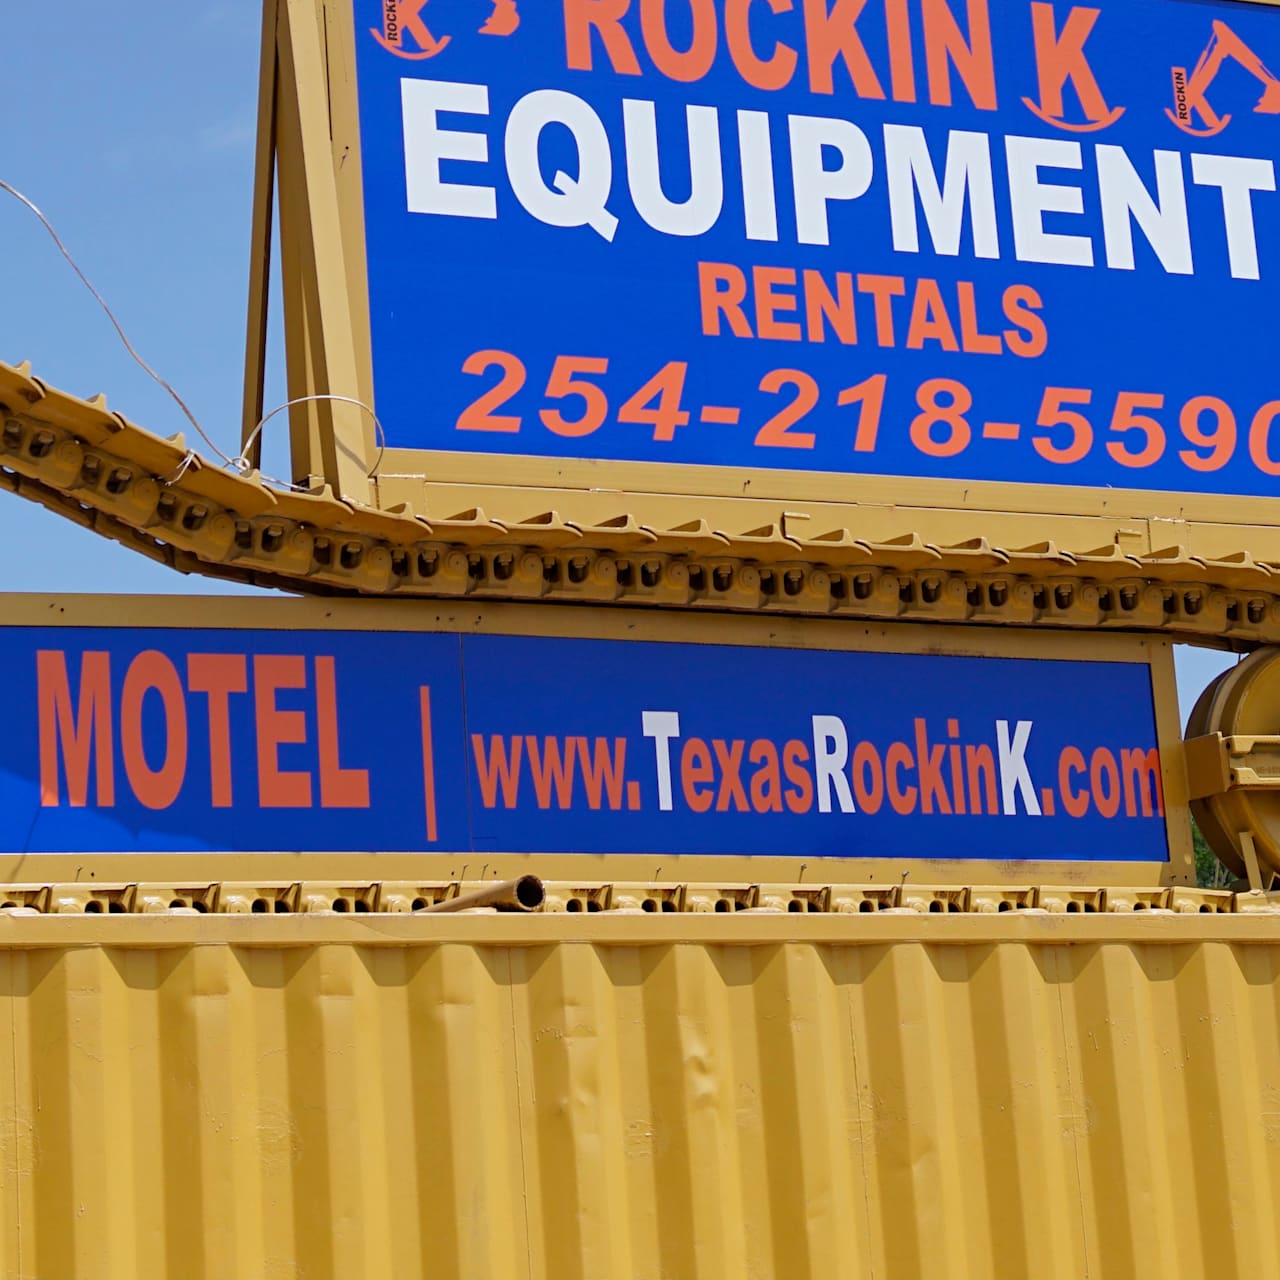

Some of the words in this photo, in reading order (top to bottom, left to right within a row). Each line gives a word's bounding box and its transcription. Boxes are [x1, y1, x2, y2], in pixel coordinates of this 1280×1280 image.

[1030, 1, 1110, 123] K
[1174, 72, 1189, 120] ROCKIN
[400, 76, 1277, 281] EQUIPMENT
[697, 261, 1049, 359] RENTALS
[37, 649, 371, 810] MOTEL
[471, 710, 1165, 819] www.TexasRockinK.com
